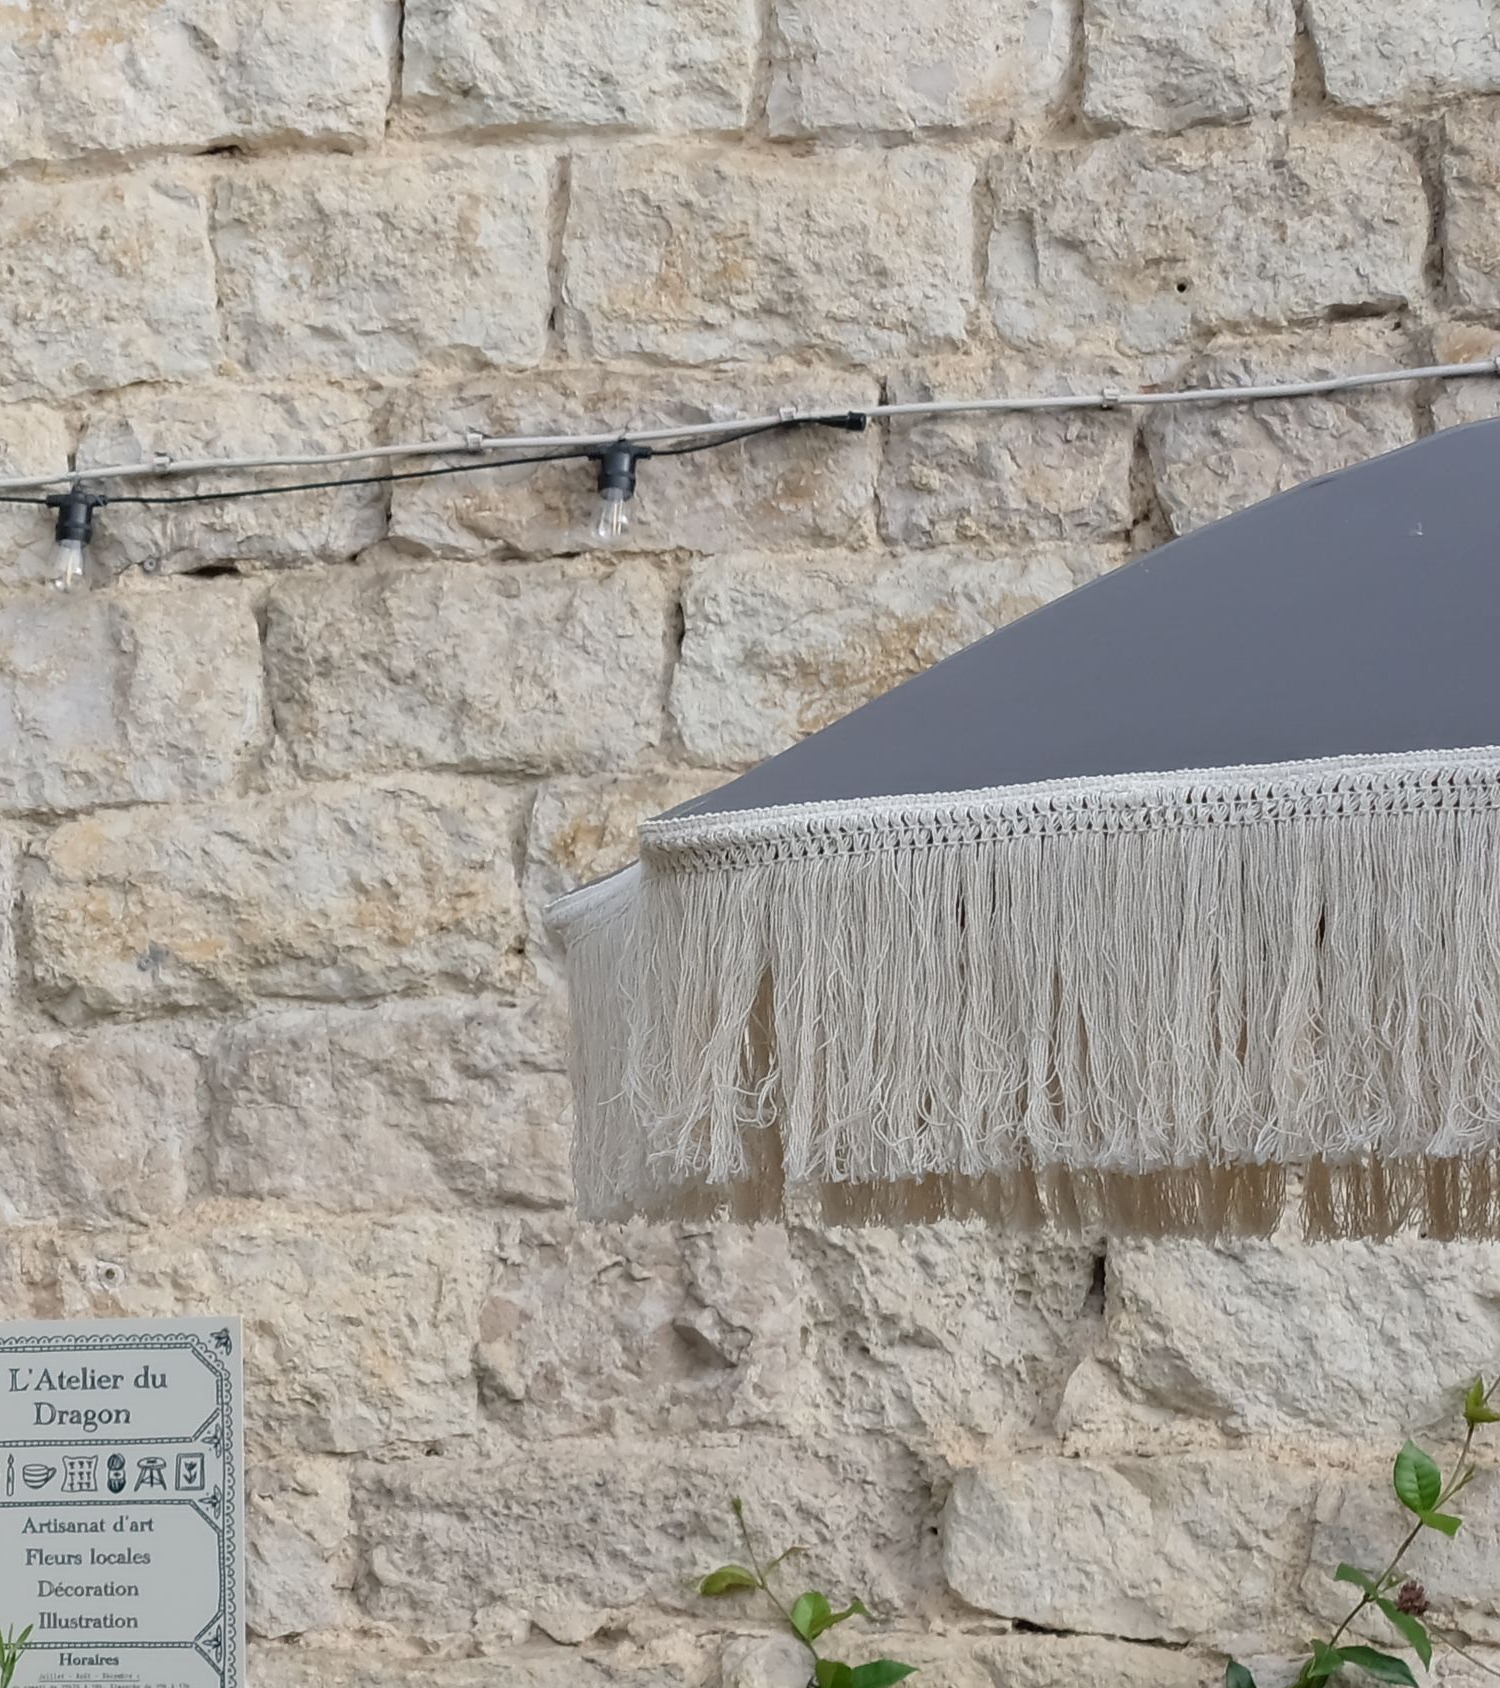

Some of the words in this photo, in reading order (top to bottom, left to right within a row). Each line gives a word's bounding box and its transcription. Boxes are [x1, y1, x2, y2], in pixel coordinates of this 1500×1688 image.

[8, 1367, 125, 1393] L'Atelier
[133, 1365, 168, 1390] du
[33, 1402, 132, 1432] Dragon
[21, 1516, 106, 1535] Artisanat
[112, 1515, 155, 1533] d'art
[25, 1548, 83, 1566] Fleurs
[90, 1547, 151, 1566] locales
[37, 1580, 140, 1598] Décoration
[38, 1612, 139, 1630] Illustration
[58, 1652, 119, 1667] Horaires
